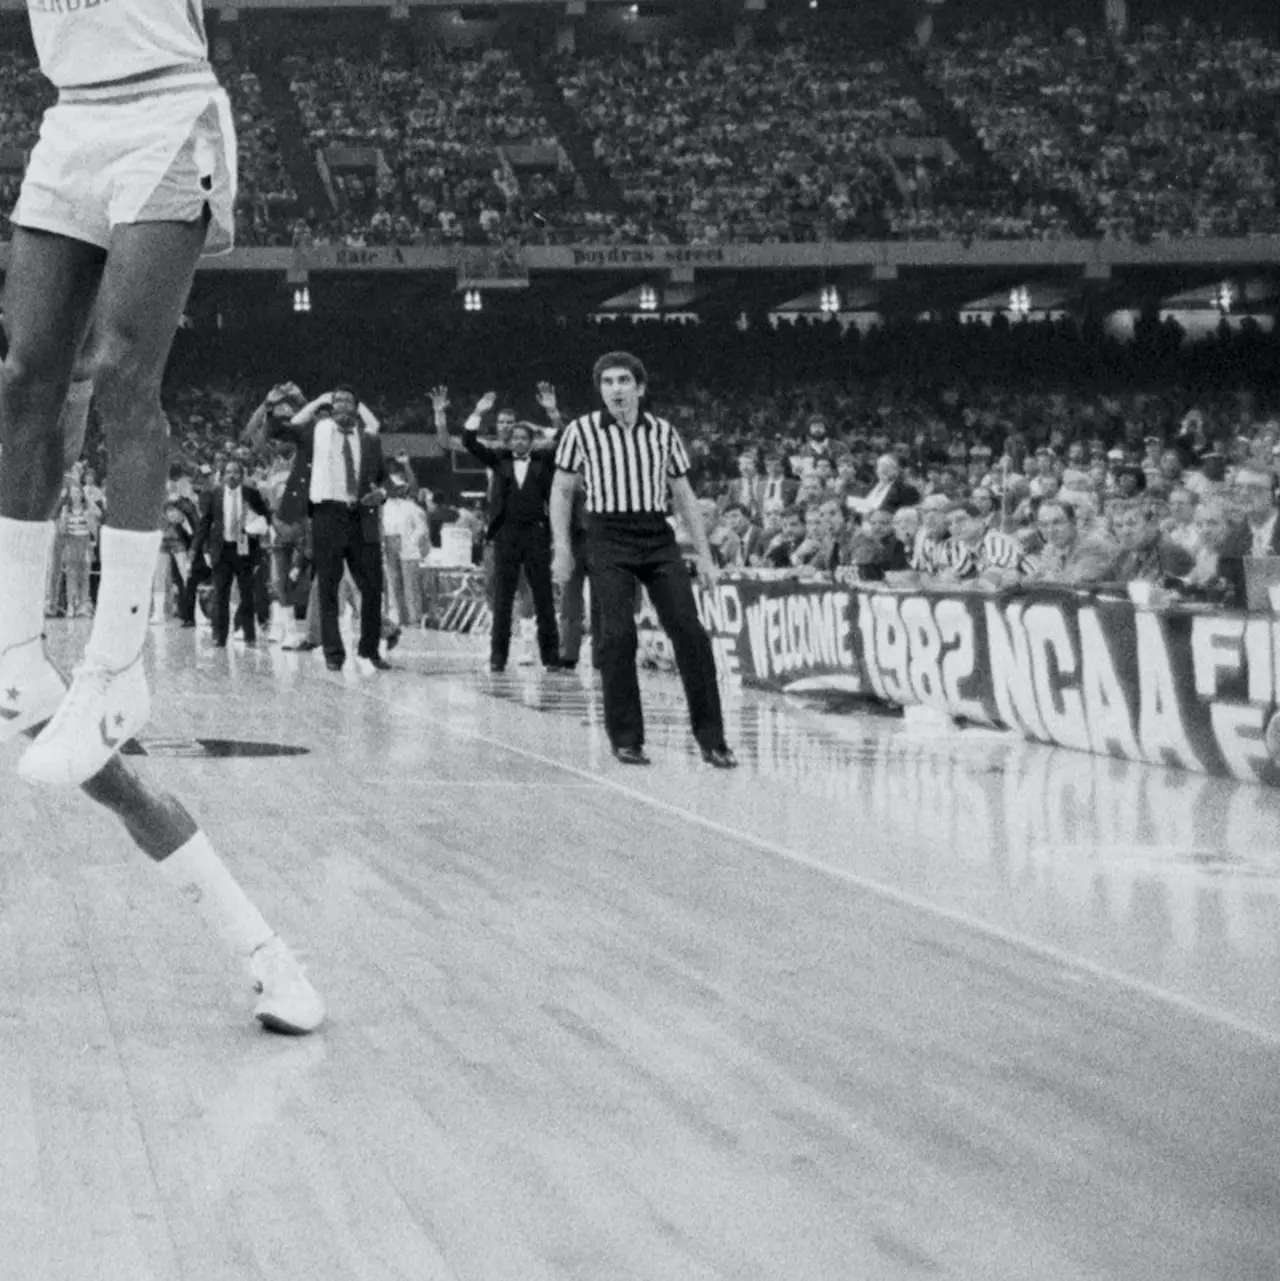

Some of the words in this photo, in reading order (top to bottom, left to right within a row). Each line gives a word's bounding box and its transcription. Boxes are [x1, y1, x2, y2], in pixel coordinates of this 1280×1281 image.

[745, 591, 854, 679] WELCOME
[858, 593, 993, 721] 1982
[984, 600, 1208, 773] NCAA
